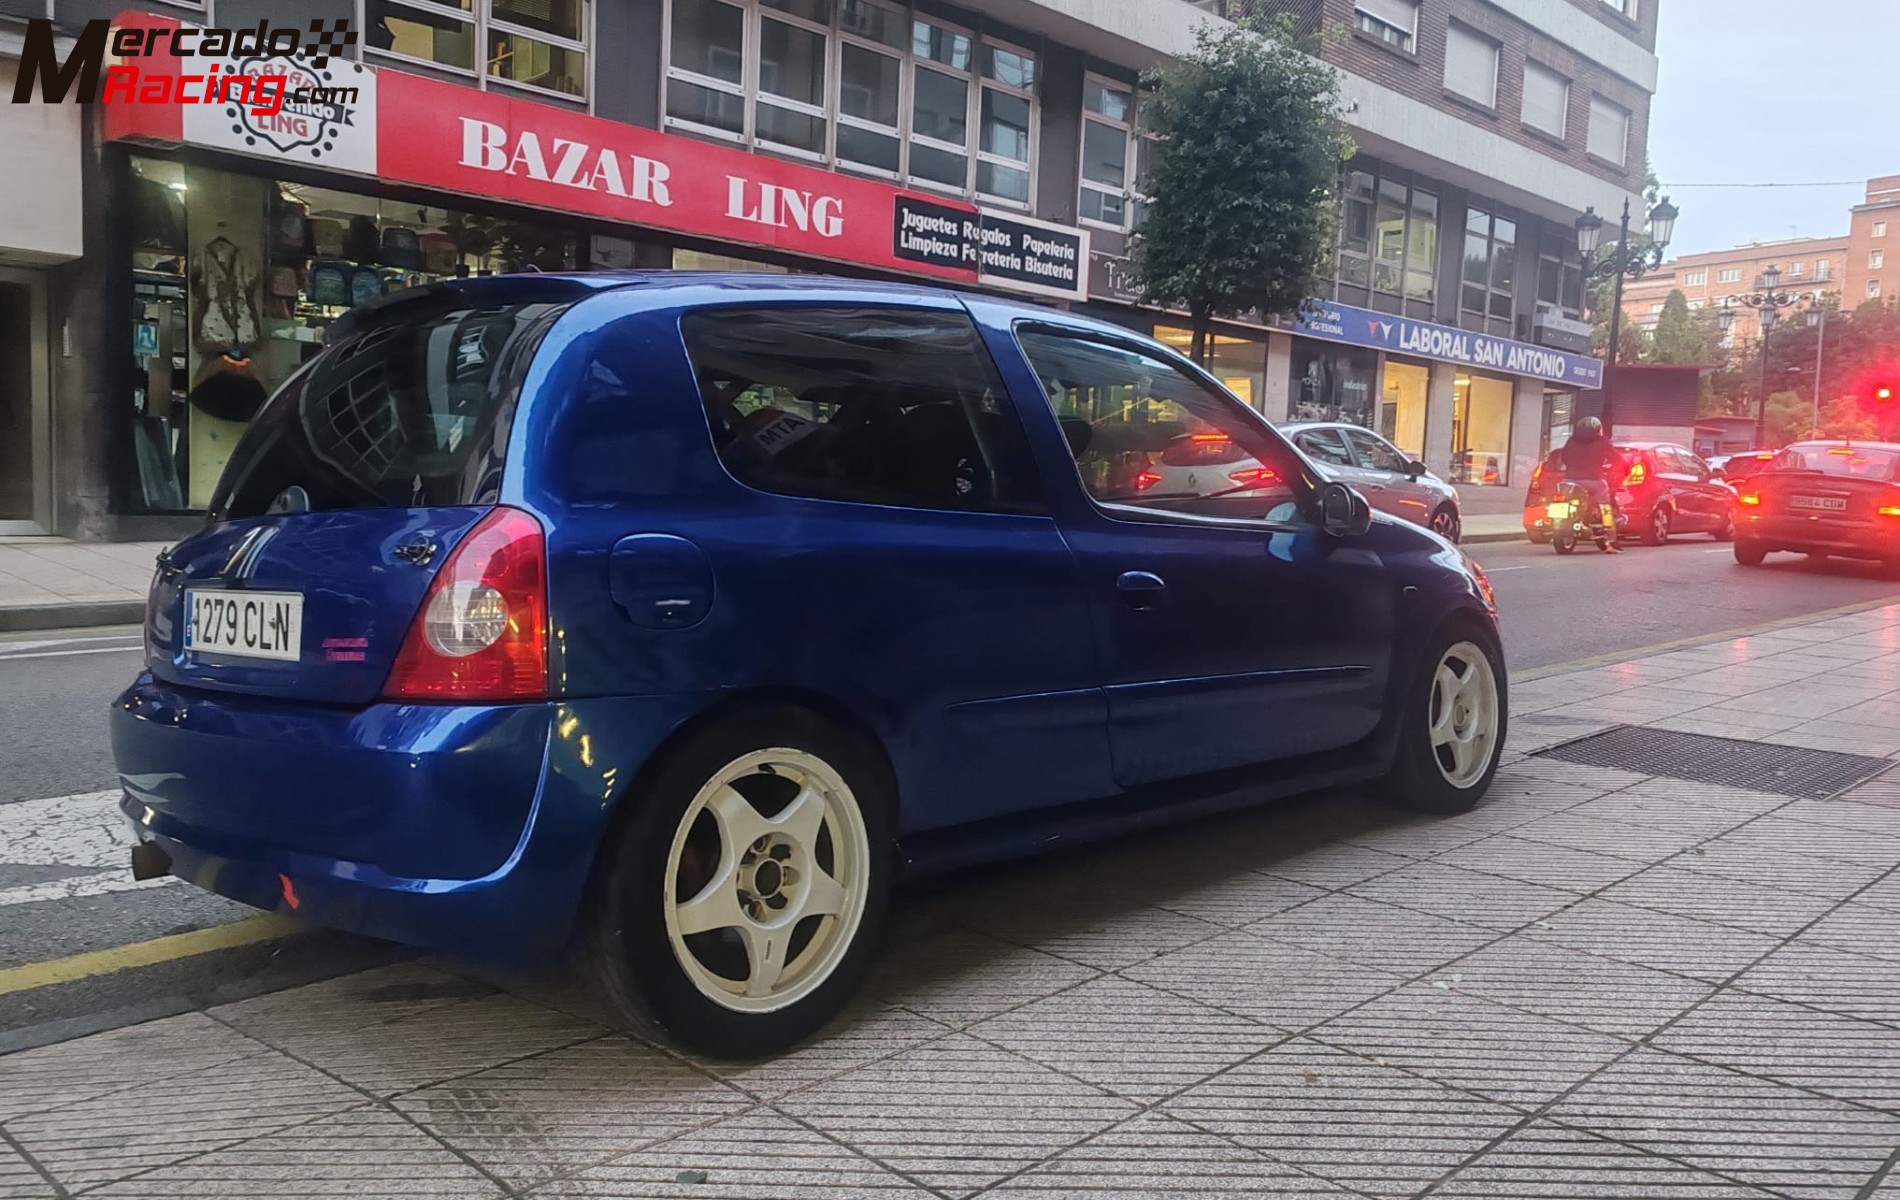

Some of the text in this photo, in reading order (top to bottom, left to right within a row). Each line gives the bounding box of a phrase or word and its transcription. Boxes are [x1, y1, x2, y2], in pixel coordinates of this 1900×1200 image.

[230, 83, 335, 119] Benido
[458, 117, 844, 238] BAZAR LING
[902, 207, 958, 236] Juguetes
[963, 221, 1011, 247] Regalos
[900, 230, 958, 257] Limpieza
[1025, 256, 1073, 281] Bisuteria
[1400, 323, 1471, 361] LABORAL
[1474, 339, 1504, 366] SAN
[1506, 346, 1565, 378] ANTONIO
[758, 418, 805, 445] MTA
[195, 598, 237, 645] 1279
[244, 601, 290, 652] CLN
